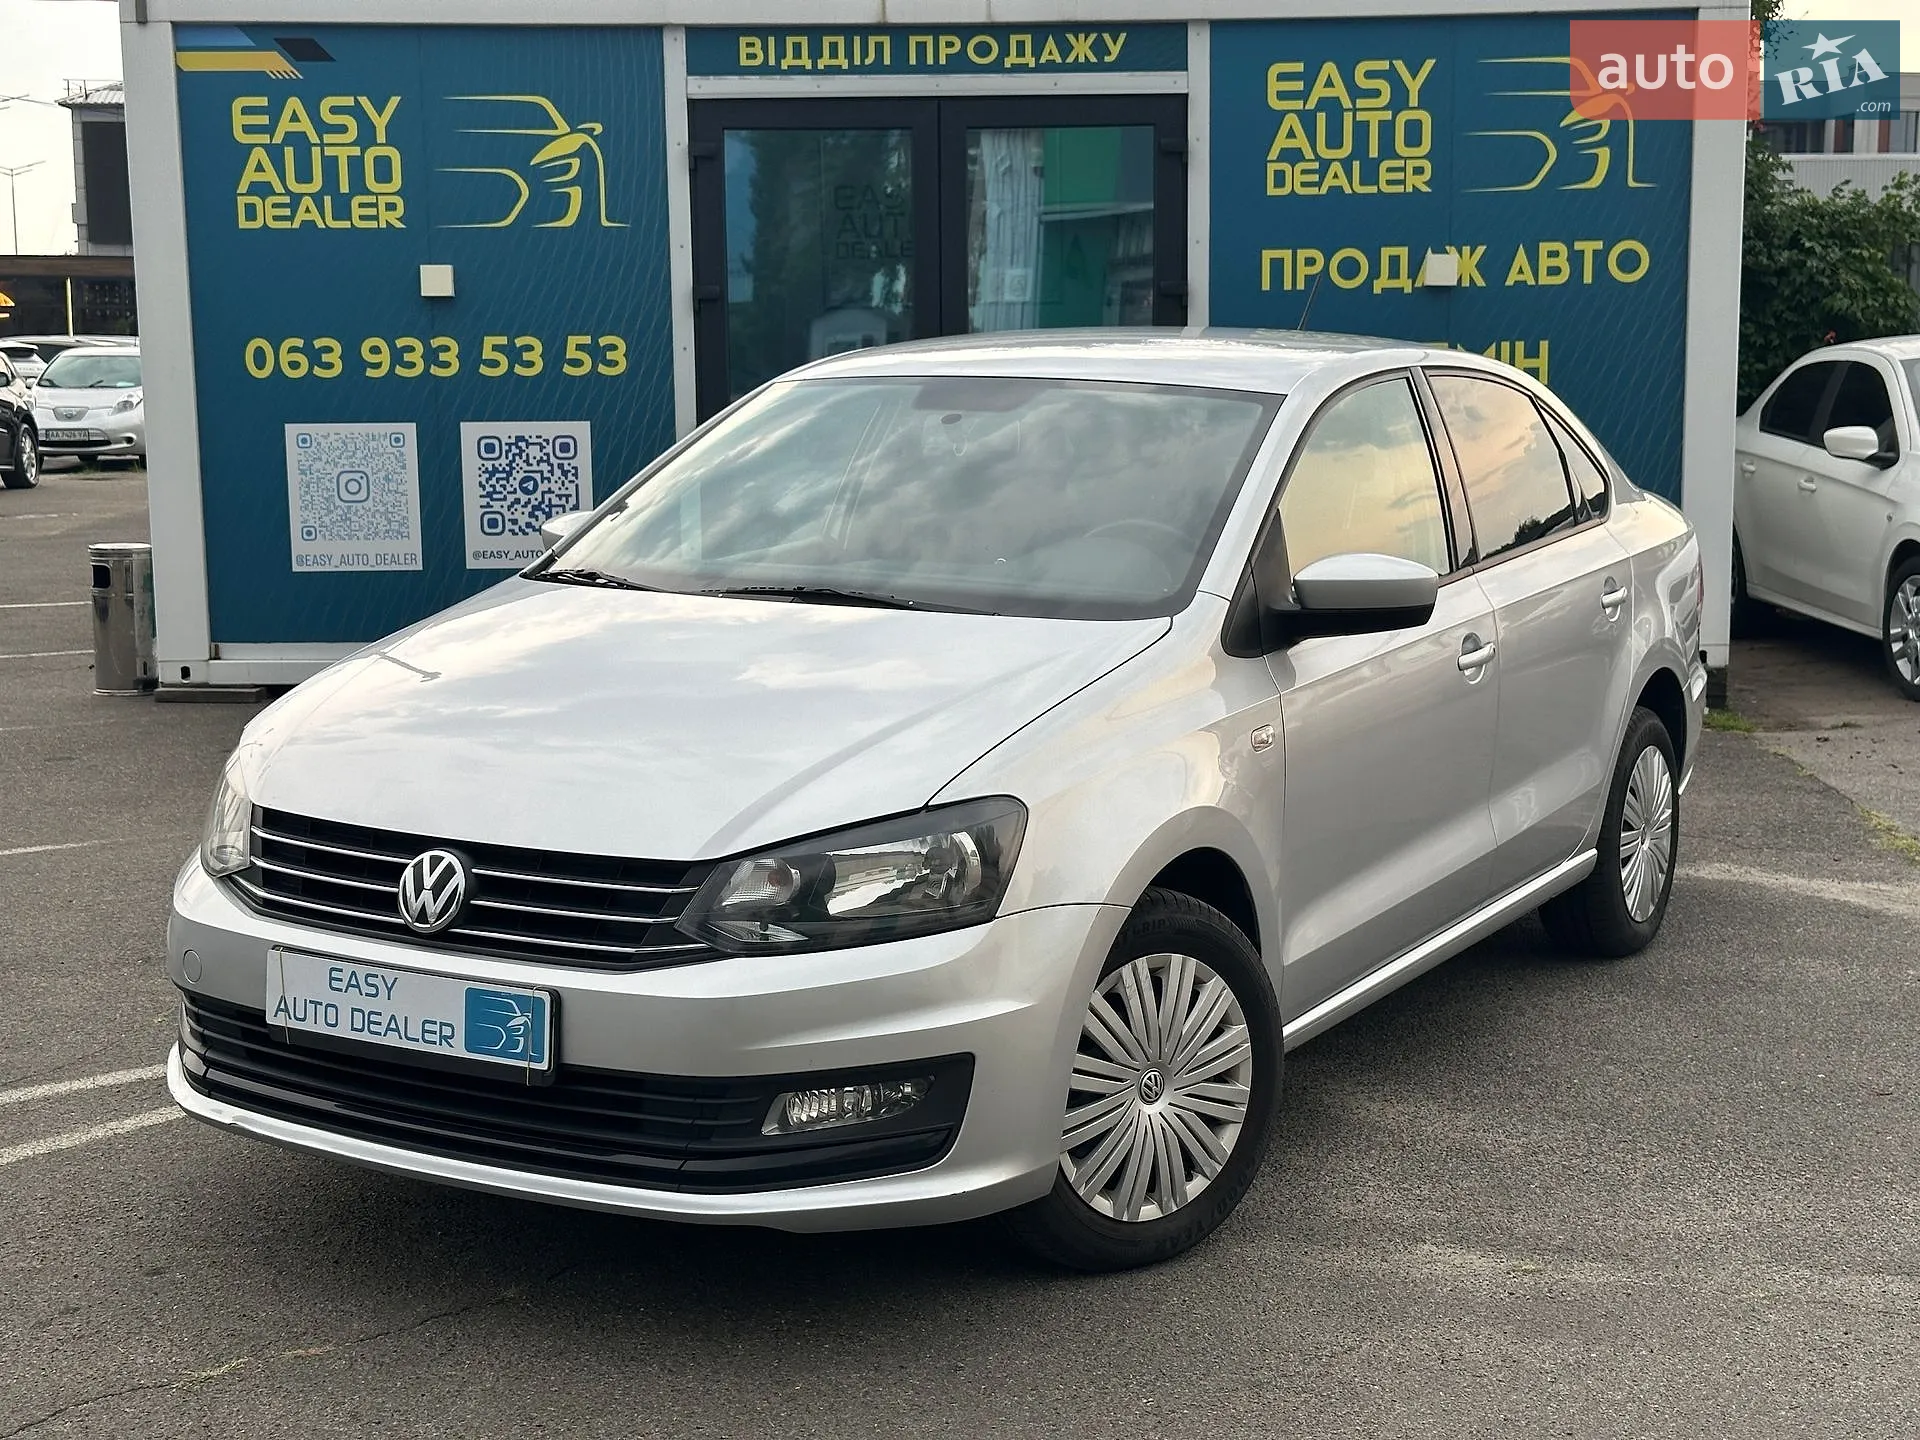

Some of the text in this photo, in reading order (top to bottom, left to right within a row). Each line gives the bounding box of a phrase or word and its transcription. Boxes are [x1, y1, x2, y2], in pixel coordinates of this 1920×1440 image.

[738, 32, 1128, 69] ВІДДІЛ ПРОДАЖУ
[1266, 58, 1436, 111] EASY
[231, 96, 401, 145] EASY
[1267, 109, 1432, 160] AUTO
[237, 145, 402, 194] AUTO
[1266, 158, 1432, 197] DEALER
[237, 194, 406, 229] DEALER
[1506, 239, 1650, 286] АВТО
[244, 335, 628, 379] 063 933 53 53
[295, 552, 418, 568] @EASY_AUTO_DEALER
[327, 966, 399, 1001] EASY
[273, 995, 455, 1049] AUTO DEALER
